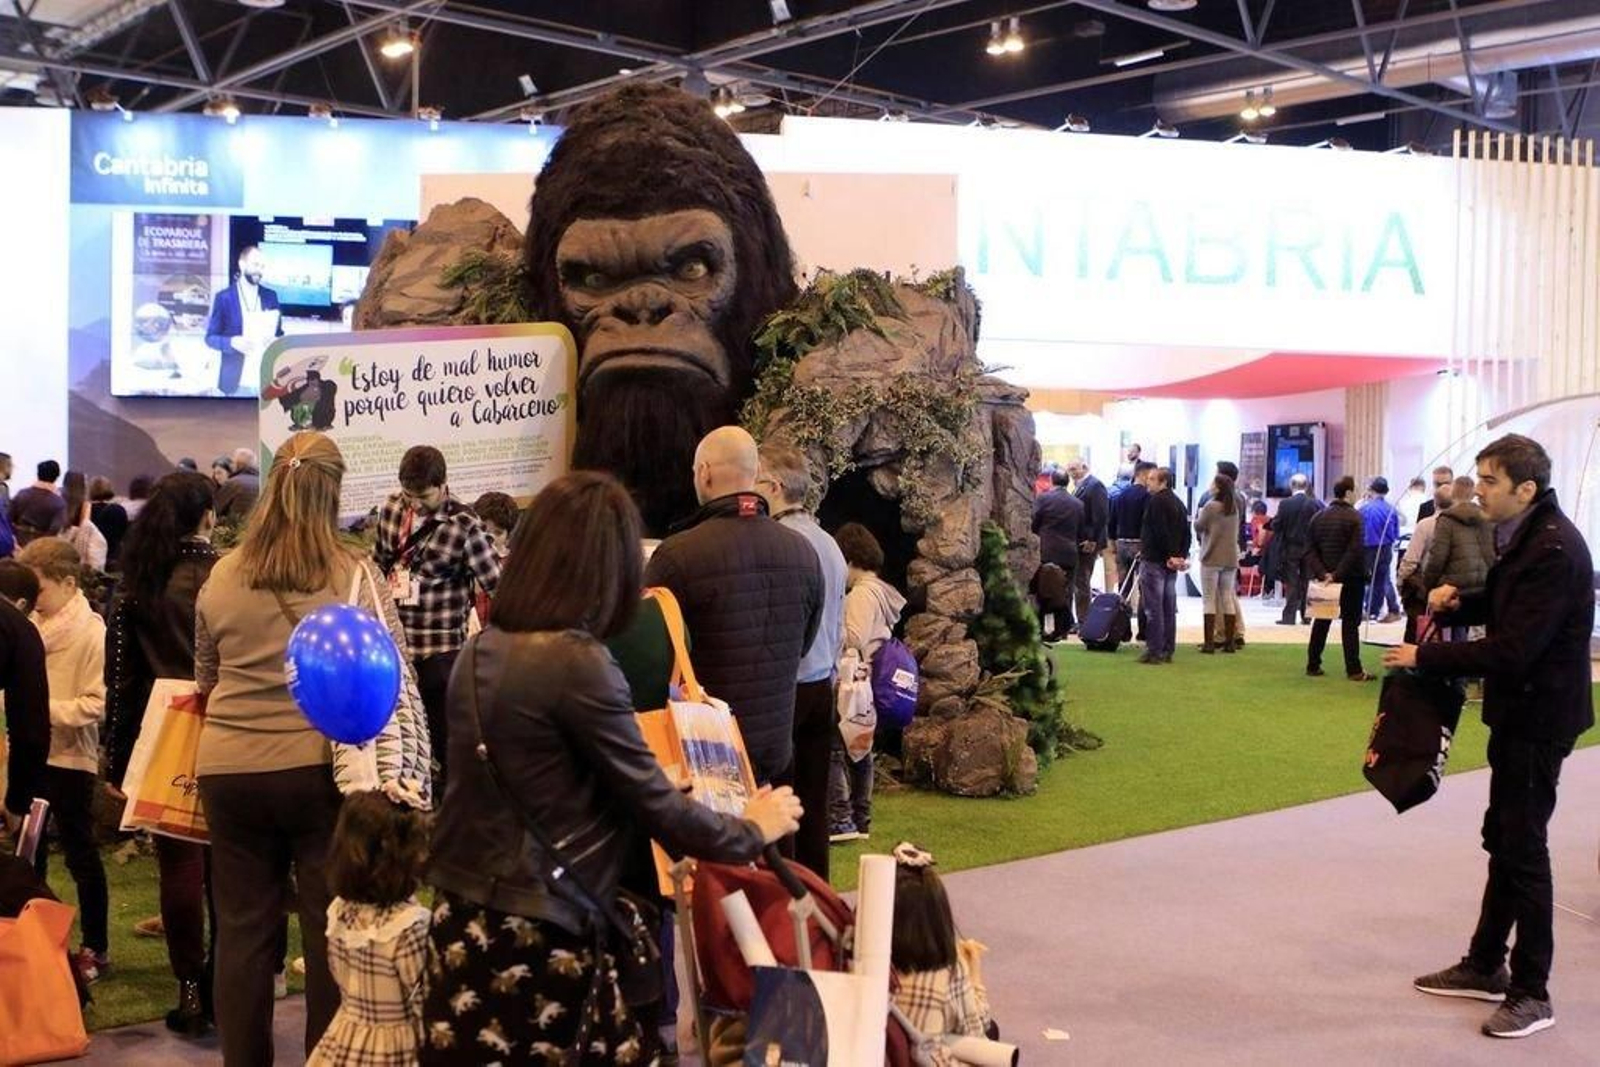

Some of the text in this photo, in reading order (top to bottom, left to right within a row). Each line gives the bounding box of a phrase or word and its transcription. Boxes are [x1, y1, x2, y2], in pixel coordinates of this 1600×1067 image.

[93, 151, 210, 177] Cantabria
[143, 226, 203, 240] ECOPARQUE
[138, 237, 209, 251] DE TRASMIERA
[412, 355, 436, 382] de
[443, 349, 481, 377] mal
[487, 348, 543, 372] humor
[344, 372, 539, 426] porque quiero volver
[450, 412, 463, 428] a
